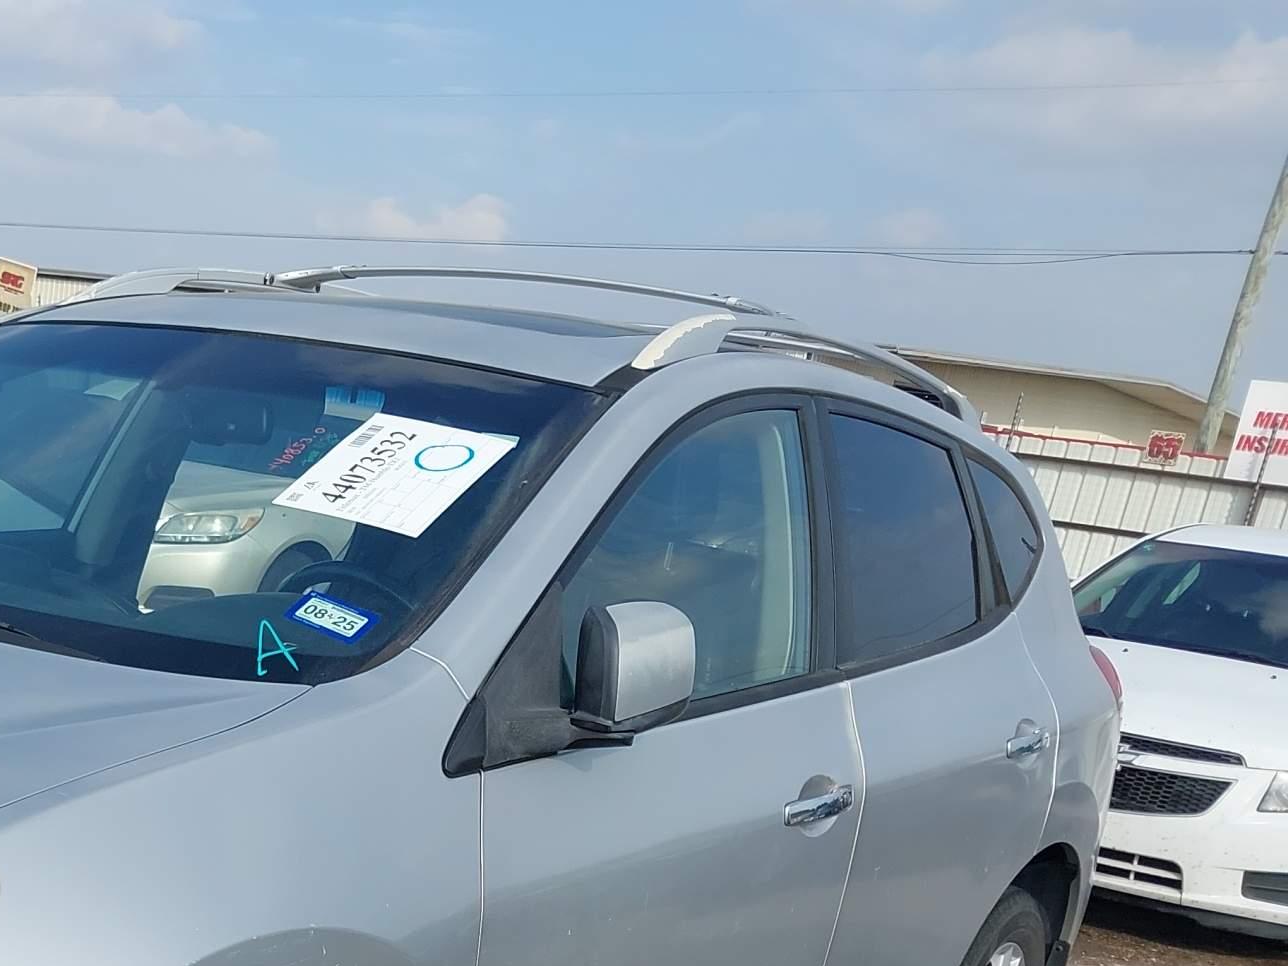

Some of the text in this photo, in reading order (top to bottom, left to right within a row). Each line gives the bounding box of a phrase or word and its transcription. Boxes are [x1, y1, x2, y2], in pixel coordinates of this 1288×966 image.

[322, 431, 417, 503] 44073532
[303, 604, 328, 620] 08
[331, 615, 359, 632] 25
[257, 619, 299, 676] A
